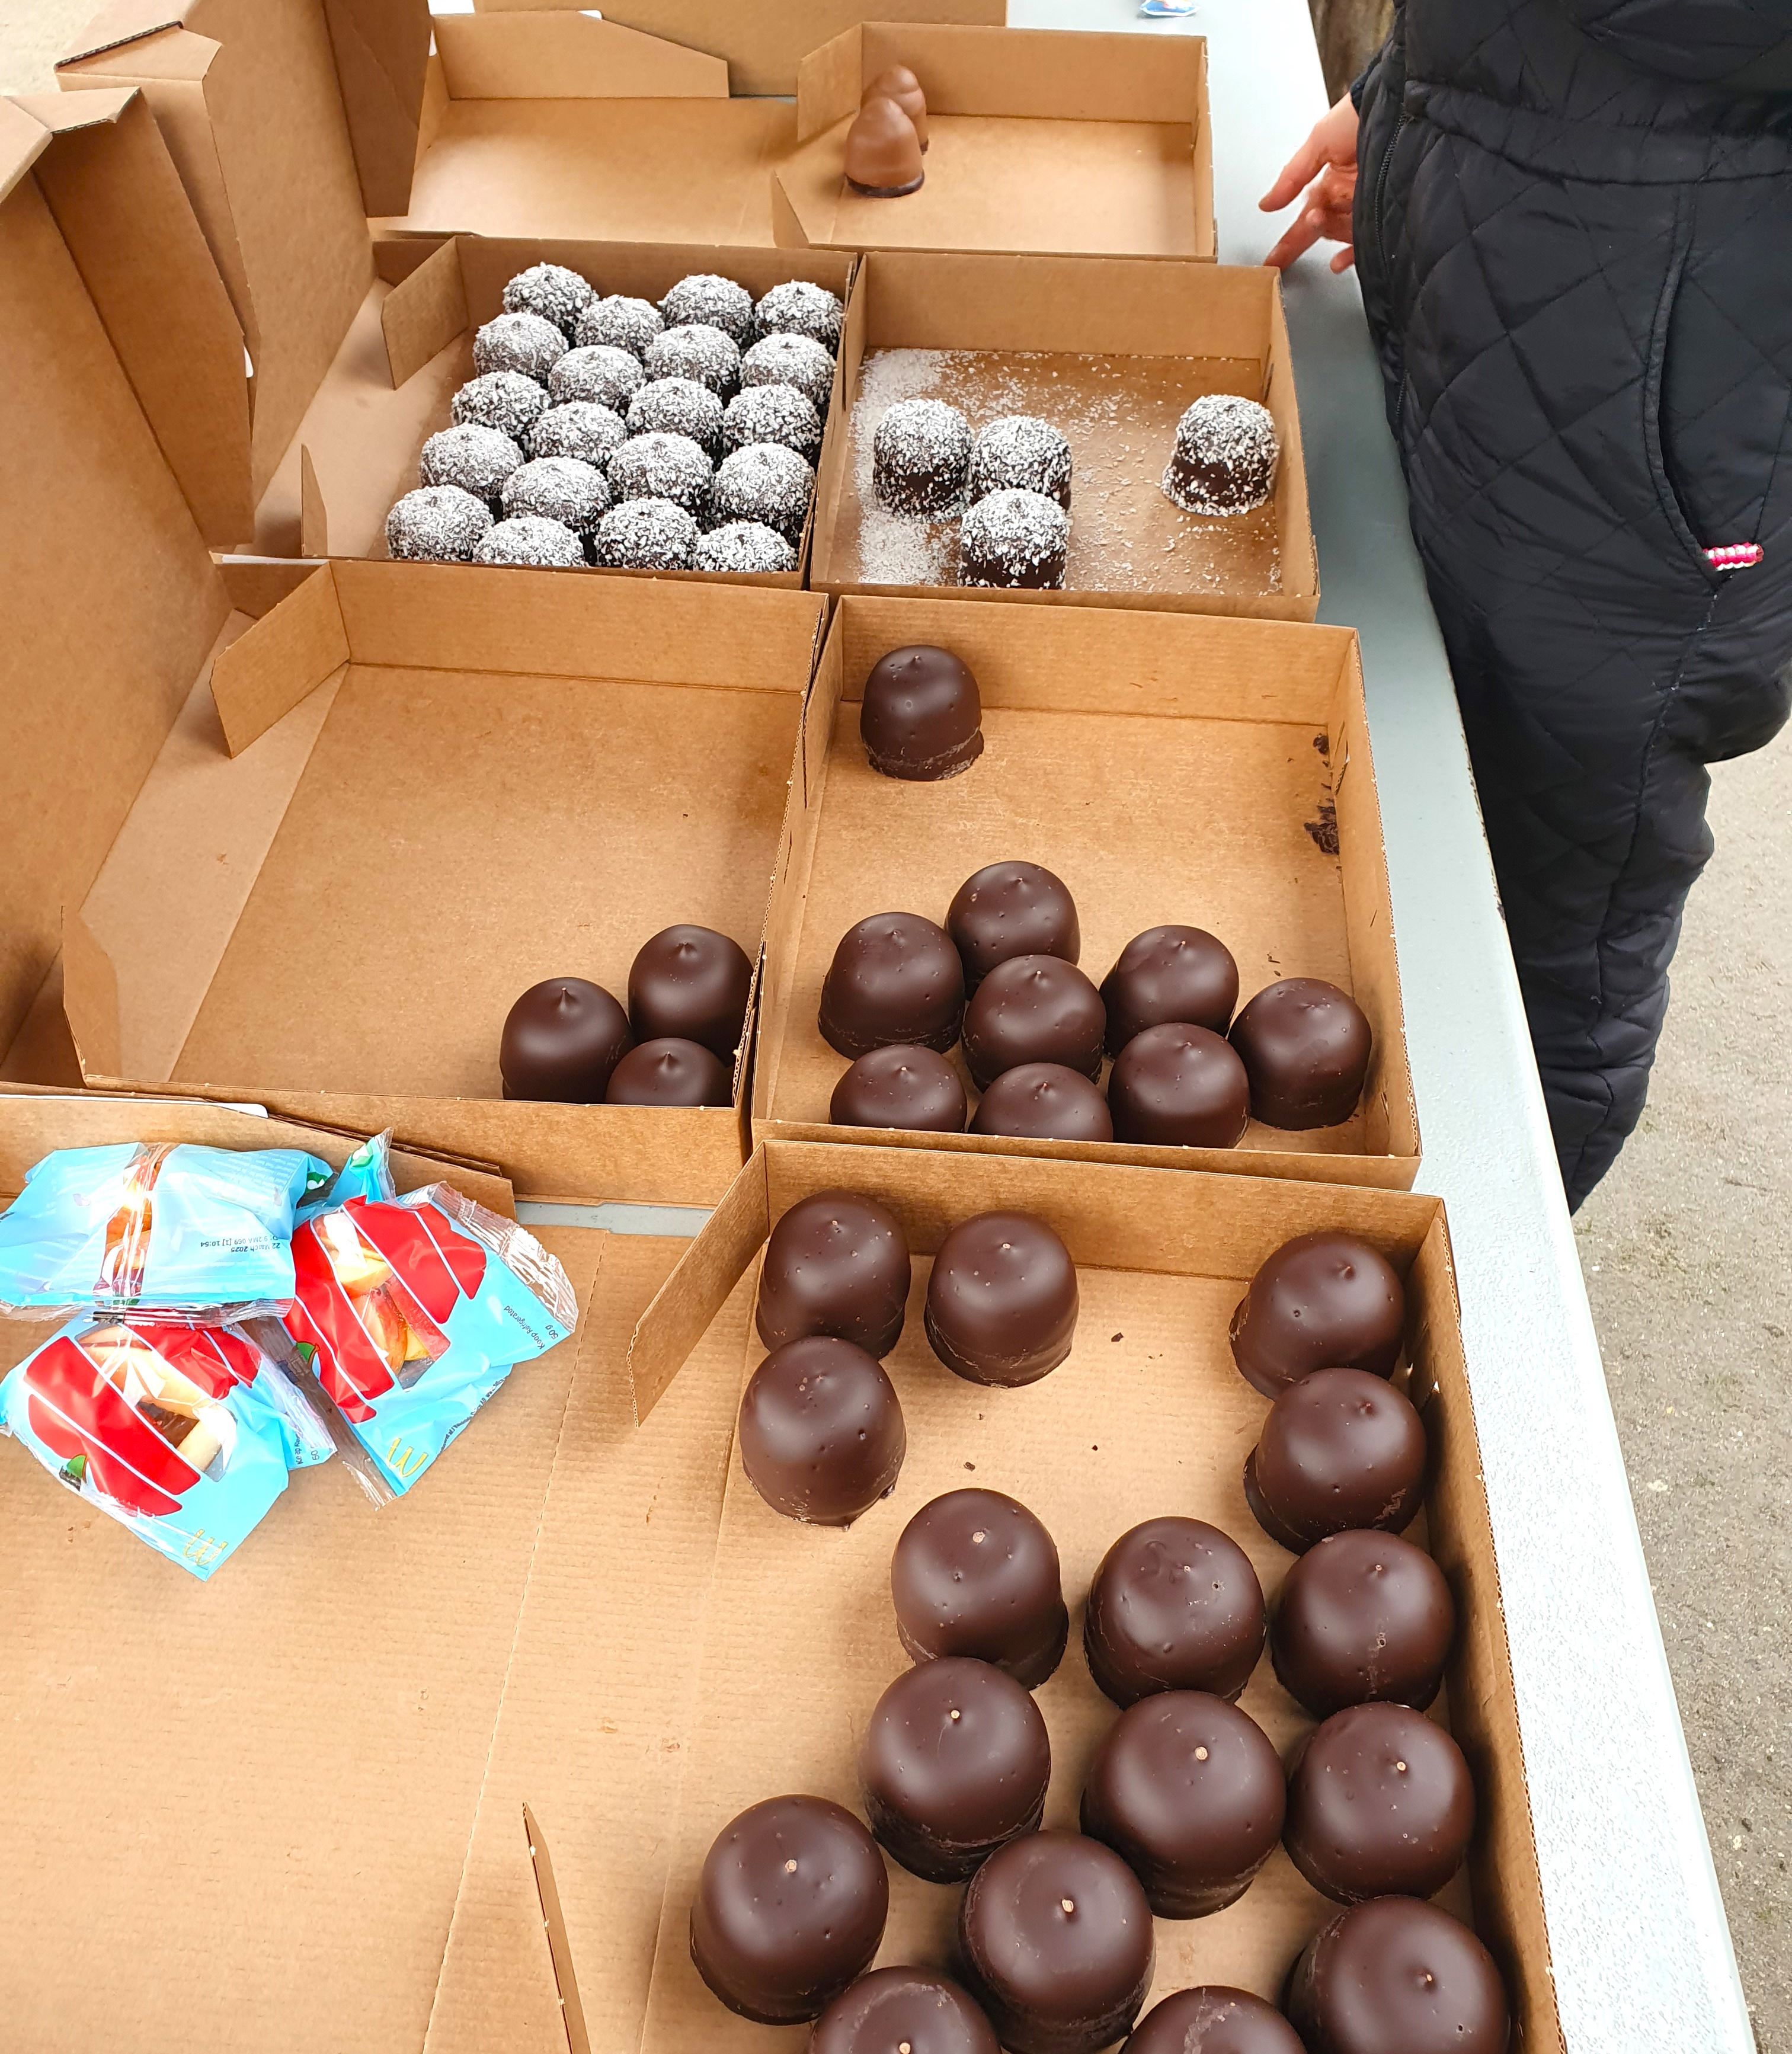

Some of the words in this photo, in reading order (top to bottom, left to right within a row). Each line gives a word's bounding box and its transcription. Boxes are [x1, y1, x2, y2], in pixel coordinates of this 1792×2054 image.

[222, 1238, 232, 1246] [1]
[503, 1306, 533, 1334] Refrigerated
[531, 1332, 545, 1350] Keep
[311, 1450, 320, 1461] 50
